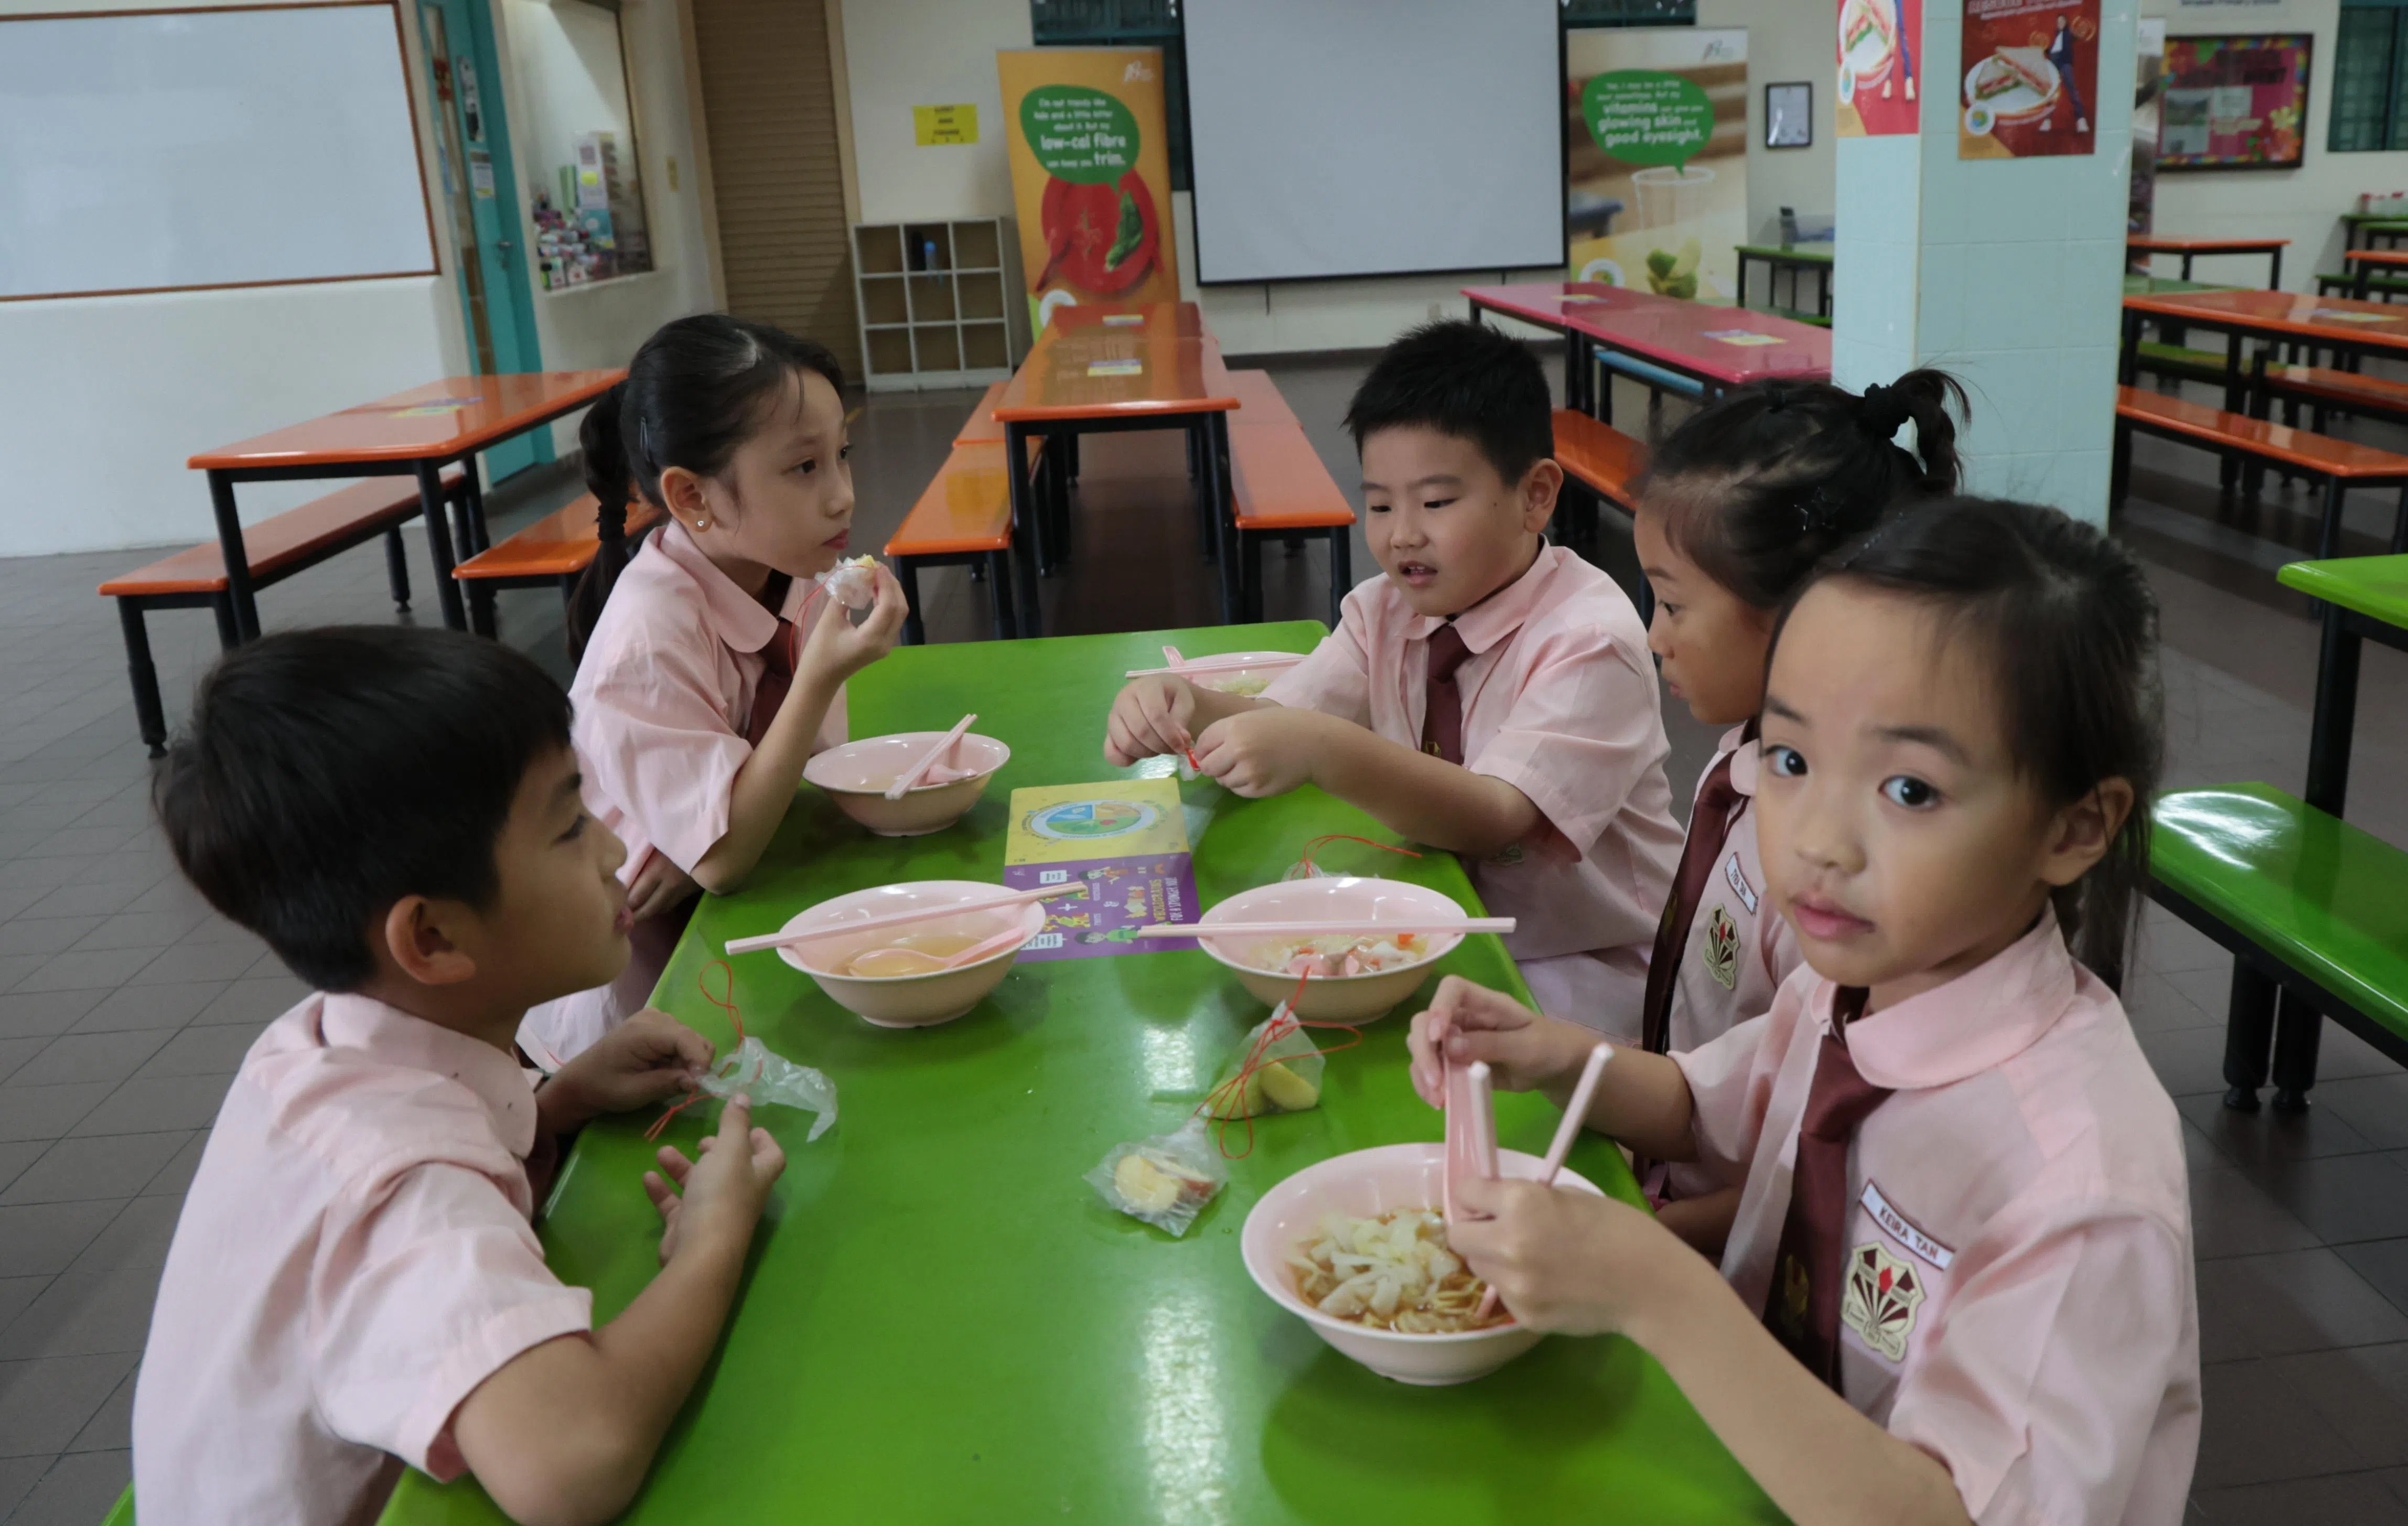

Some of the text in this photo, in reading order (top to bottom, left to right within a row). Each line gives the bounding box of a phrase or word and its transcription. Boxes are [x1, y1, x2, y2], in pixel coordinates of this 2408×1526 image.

[1603, 100, 1658, 115] vitamins
[1598, 115, 1651, 134] glowing
[1654, 114, 1682, 127] skin
[1040, 132, 1126, 151] low-cal fibre
[1605, 130, 1639, 149] good
[1879, 1206, 1939, 1260] KEIRA TAN
